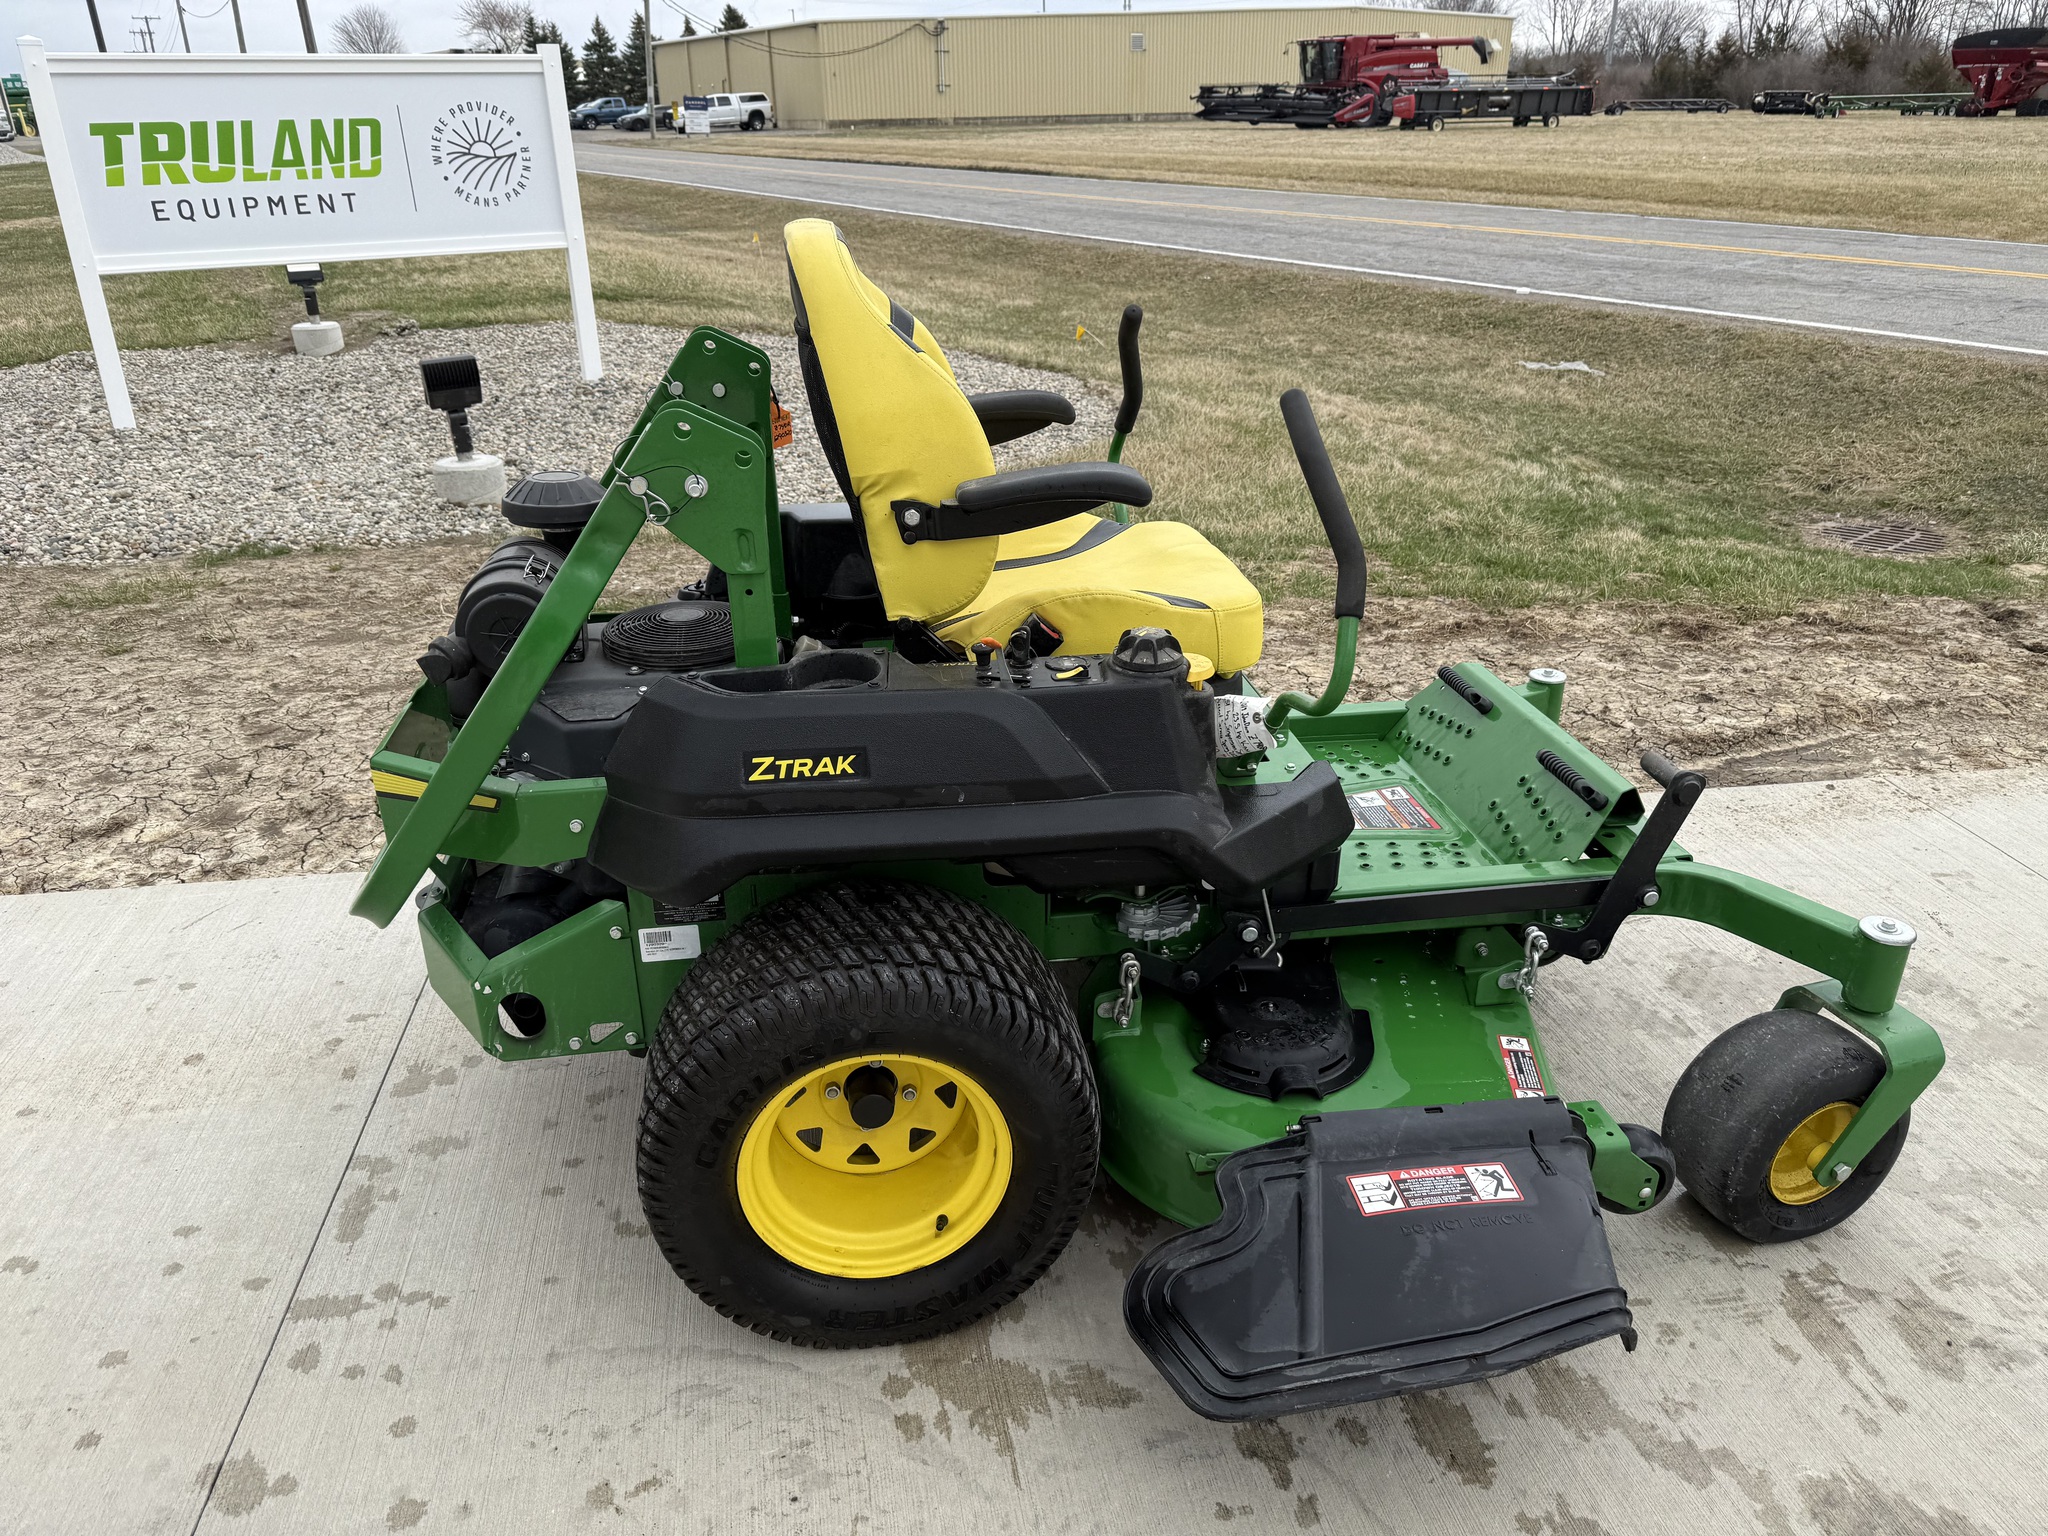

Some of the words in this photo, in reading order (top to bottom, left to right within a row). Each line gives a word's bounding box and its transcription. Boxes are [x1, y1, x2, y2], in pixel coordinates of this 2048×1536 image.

[89, 117, 382, 187] TRULAND
[431, 117, 449, 166] WHERE
[448, 101, 515, 126] PROVIDER
[454, 186, 499, 207] MEANS
[504, 145, 532, 202] PARTNER
[151, 192, 357, 222] EQUIPMENT
[748, 754, 857, 782] ZTRAK
[1410, 1167, 1456, 1177] DANGER
[1400, 1224, 1424, 1237] DO
[1431, 1218, 1464, 1234] NOT
[1468, 1212, 1535, 1228] REMOVE
[824, 1255, 1012, 1333] MASTER
